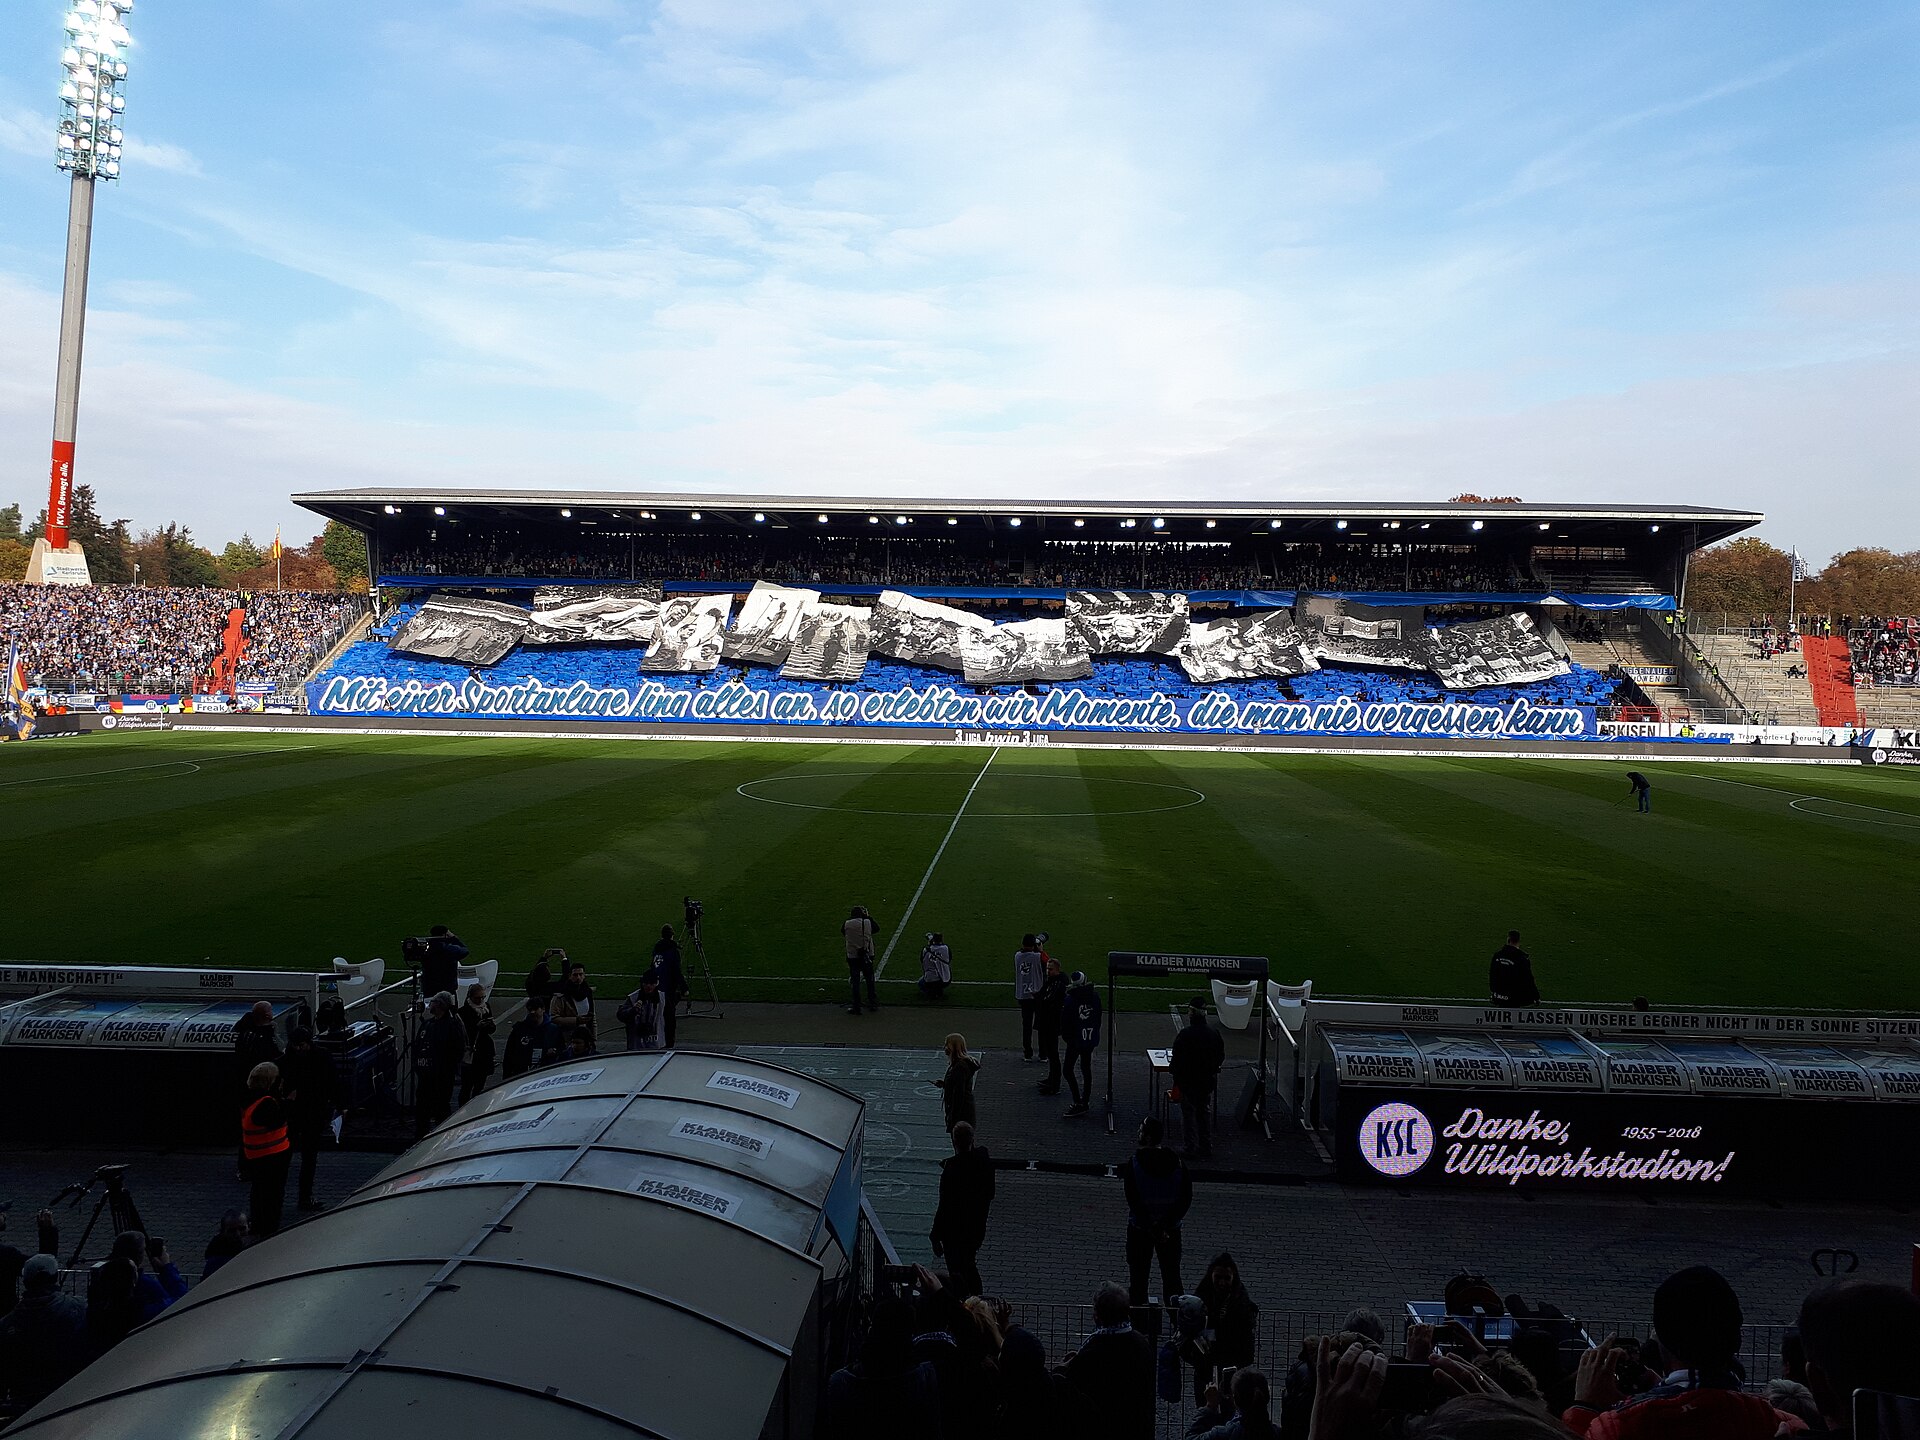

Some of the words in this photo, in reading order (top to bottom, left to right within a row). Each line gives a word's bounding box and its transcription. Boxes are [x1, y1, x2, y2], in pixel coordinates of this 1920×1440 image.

[58, 477, 69, 507] Bewegt
[196, 703, 225, 712] Freak
[321, 677, 386, 711] Mit
[387, 681, 456, 712] einer
[694, 684, 768, 718] alles
[772, 690, 818, 720] an,
[824, 691, 859, 718] so
[863, 687, 981, 722] erlebten
[984, 691, 1038, 723] wir
[1040, 690, 1181, 727] Momente,
[1189, 691, 1238, 728] die
[1243, 703, 1311, 730] man
[1312, 697, 1359, 731] nie
[1506, 699, 1583, 735] kann
[955, 729, 963, 742] 3
[965, 733, 981, 742] LIGA
[985, 731, 1020, 743] bwin
[1022, 730, 1031, 743] 3
[1033, 734, 1049, 744] LIGA
[1600, 724, 1656, 737] RKISEN
[1186, 956, 1241, 969] MARKISEN
[1402, 1014, 1439, 1022] MARKISEN
[1518, 1011, 1573, 1026] LASSEN
[1579, 1013, 1636, 1027] UNSERE
[1642, 1014, 1700, 1029] GEGNER
[1705, 1016, 1750, 1030] NICHT
[1755, 1017, 1770, 1030] IN
[1776, 1018, 1805, 1032] DER
[1810, 1019, 1860, 1034] SONNE
[1866, 1021, 1920, 1036] SITZEN
[17, 1028, 84, 1041] MARKISEN
[99, 1030, 165, 1043] MARKISEN
[182, 1032, 240, 1044] MARKISE
[1081, 1027, 1094, 1041] 07
[1347, 1065, 1416, 1078] MARKISEN
[1435, 1068, 1504, 1081] MARKISEN
[1523, 1070, 1593, 1084] MARKISEN
[1612, 1073, 1682, 1087] MARKISEN
[1700, 1075, 1771, 1089] MARKISEN
[1793, 1078, 1865, 1093] MARKISEN
[716, 1079, 789, 1103] MARKISEN
[1443, 1106, 1572, 1146] Danke,
[679, 1127, 761, 1153] MARKISEN
[1375, 1117, 1419, 1159] KSC
[1443, 1143, 1736, 1186] Wildparkstadion!
[636, 1185, 727, 1214] MARKISEN
